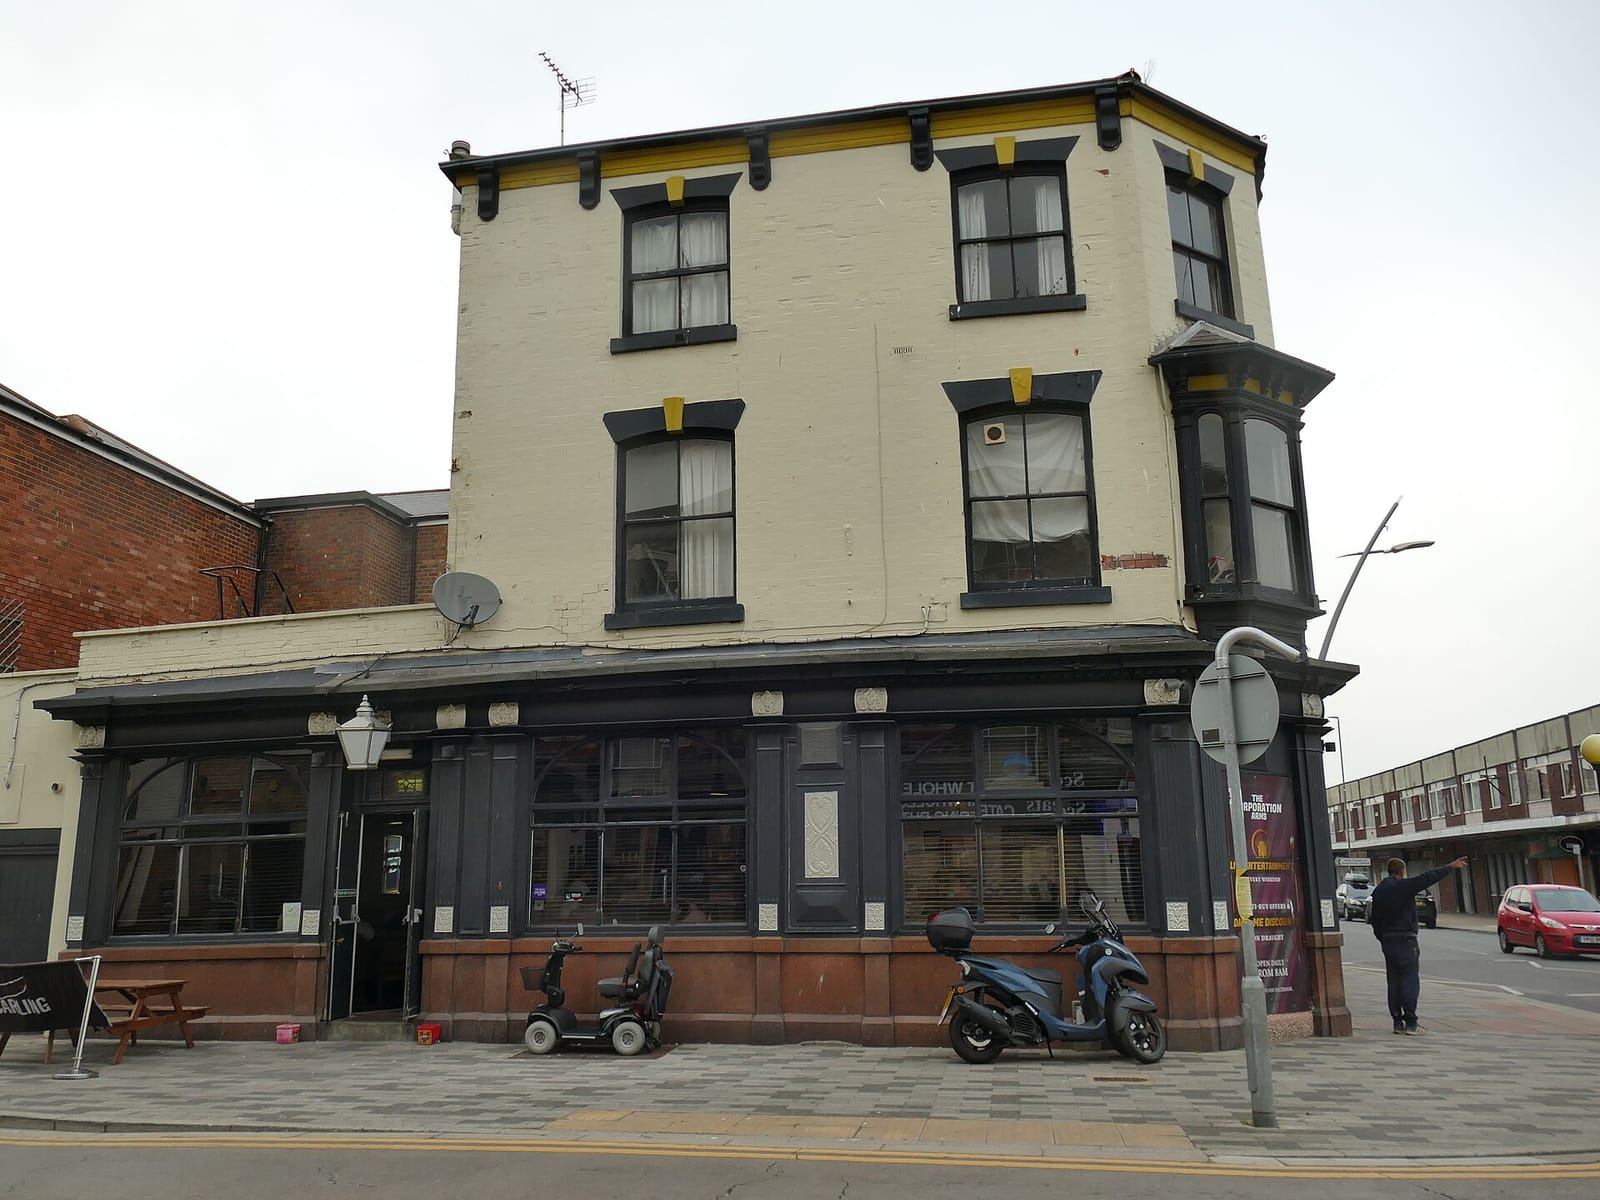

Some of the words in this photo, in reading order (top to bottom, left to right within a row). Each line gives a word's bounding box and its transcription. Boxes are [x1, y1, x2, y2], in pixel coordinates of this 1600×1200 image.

[1251, 794, 1264, 803] THE
[1243, 802, 1282, 814] RPORATION
[1251, 812, 1268, 821] ARMS
[1247, 861, 1293, 871] NTERTAINMENT
[1258, 969, 1274, 977] ROM
